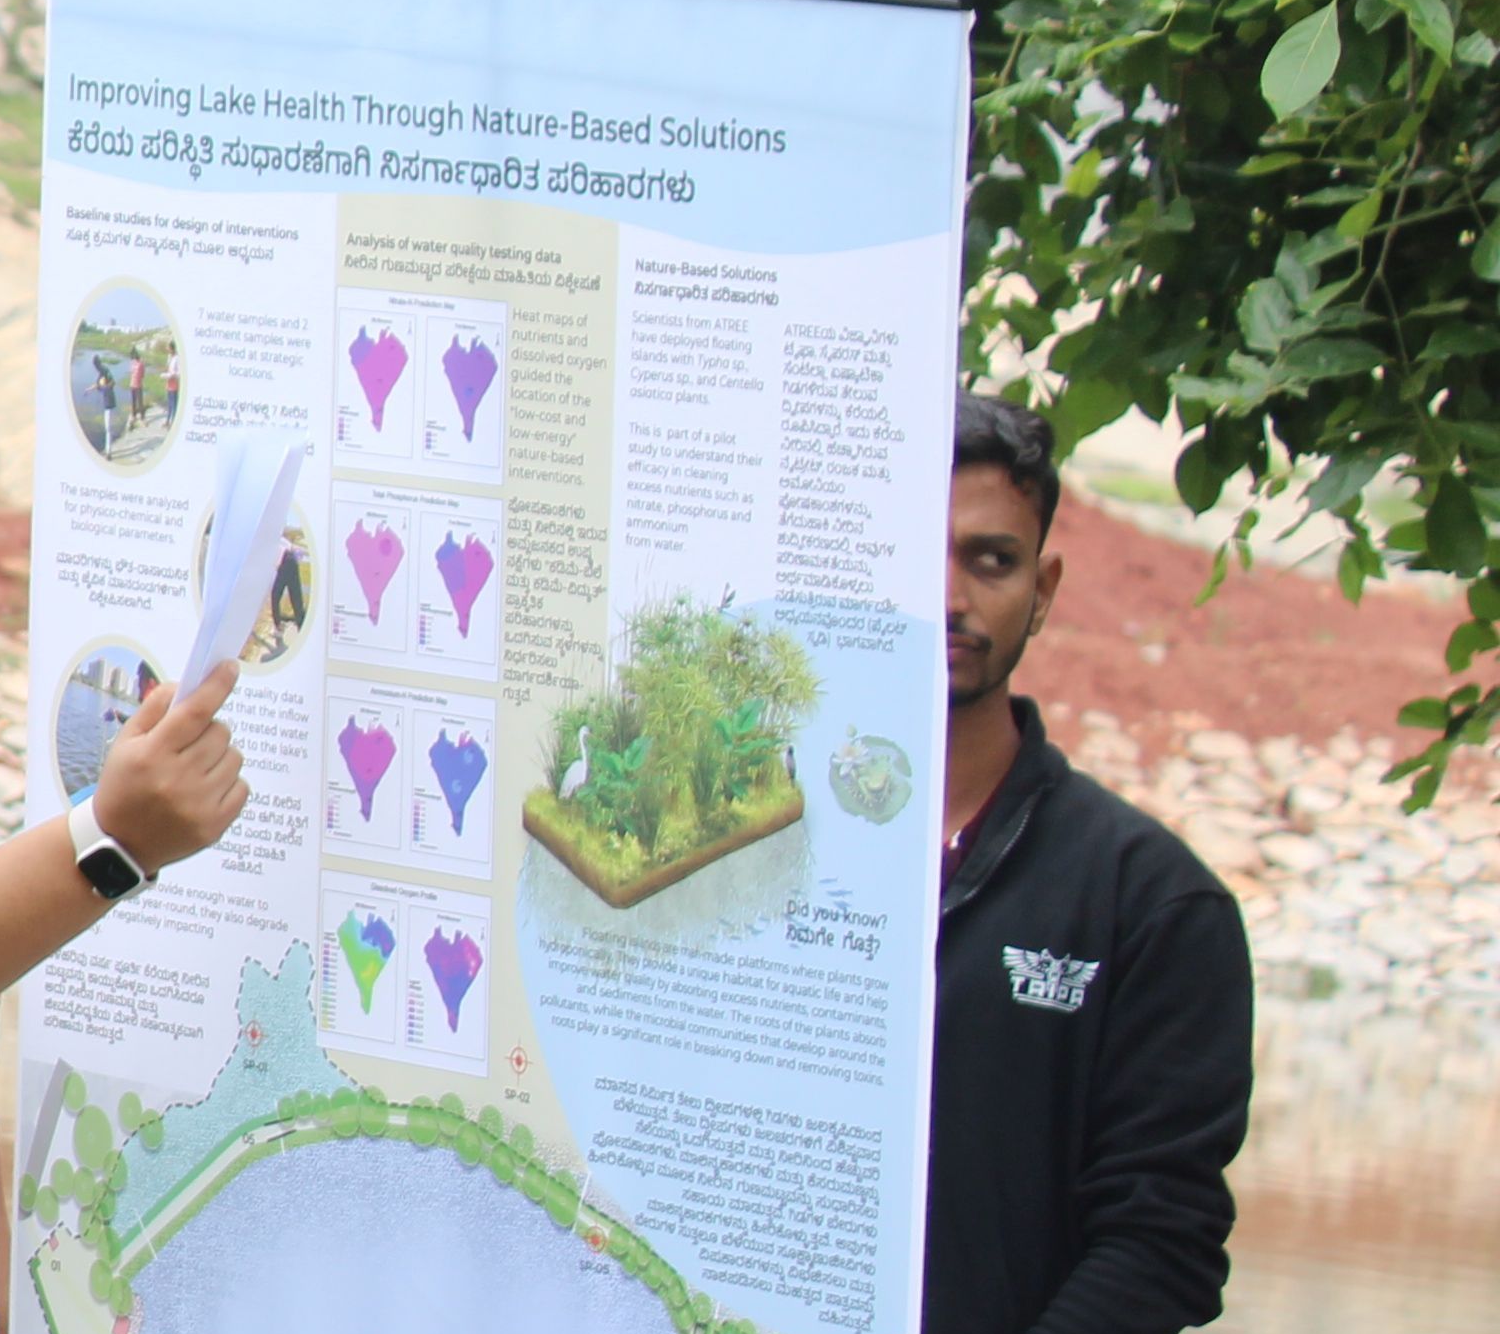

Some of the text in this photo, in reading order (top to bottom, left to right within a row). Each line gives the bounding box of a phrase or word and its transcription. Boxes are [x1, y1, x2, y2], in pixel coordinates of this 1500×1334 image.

[70, 74, 786, 152] Improving Lake Health Through Nature-Based Solutions
[68, 122, 695, 200] ಕೆರೆಯ ಪರಿಸ್ಥಿತಿ ಸುಧಾರಣೆಗಾಗಿ ನಿಸರ್ಗಾಧಾರಿತ ಪರಿಹಾರಗಳು
[66, 206, 110, 222] Baseline
[112, 211, 152, 226] studies
[172, 216, 208, 233] design
[225, 221, 298, 239] interventions
[346, 232, 395, 250] Analysis
[411, 239, 447, 254] water
[450, 243, 486, 260] quality
[488, 245, 532, 264] testing
[534, 249, 563, 264] data
[635, 259, 777, 282] Nature-Based Solutions
[205, 311, 235, 323] water
[237, 315, 278, 328] samples
[280, 317, 300, 329] and
[511, 308, 539, 322] Heat
[542, 314, 574, 327] maps
[632, 312, 747, 333] Scientists from ATREE
[194, 327, 310, 348] sediment samples were
[511, 328, 588, 346] nutrients and
[631, 331, 753, 354] have deployed floating
[200, 344, 246, 359] collected
[260, 349, 303, 366] strategic
[510, 347, 608, 369] dissolved oxygen
[630, 348, 668, 363] islands
[670, 352, 694, 365] with
[229, 364, 273, 380] locations.
[510, 369, 573, 384] guided the
[629, 368, 673, 383] Cyperus
[695, 375, 716, 387] and
[509, 386, 555, 403] location
[571, 392, 591, 406] the
[674, 390, 709, 404] plants.
[563, 413, 587, 425] and
[629, 423, 650, 436] This
[666, 428, 689, 441] part
[712, 431, 736, 445] pilot
[508, 447, 585, 465] nature-based
[628, 443, 657, 459] study
[673, 448, 734, 463] understand
[736, 452, 762, 465] their
[508, 466, 584, 485] interventions.
[627, 460, 669, 478] efficacy
[683, 466, 730, 483] cleaning
[60, 482, 190, 511] The samples were analyzed
[79, 503, 162, 523] physico-chemical
[164, 514, 183, 526] and
[70, 518, 174, 542] biological parameters.
[787, 899, 888, 929] Did you know?
